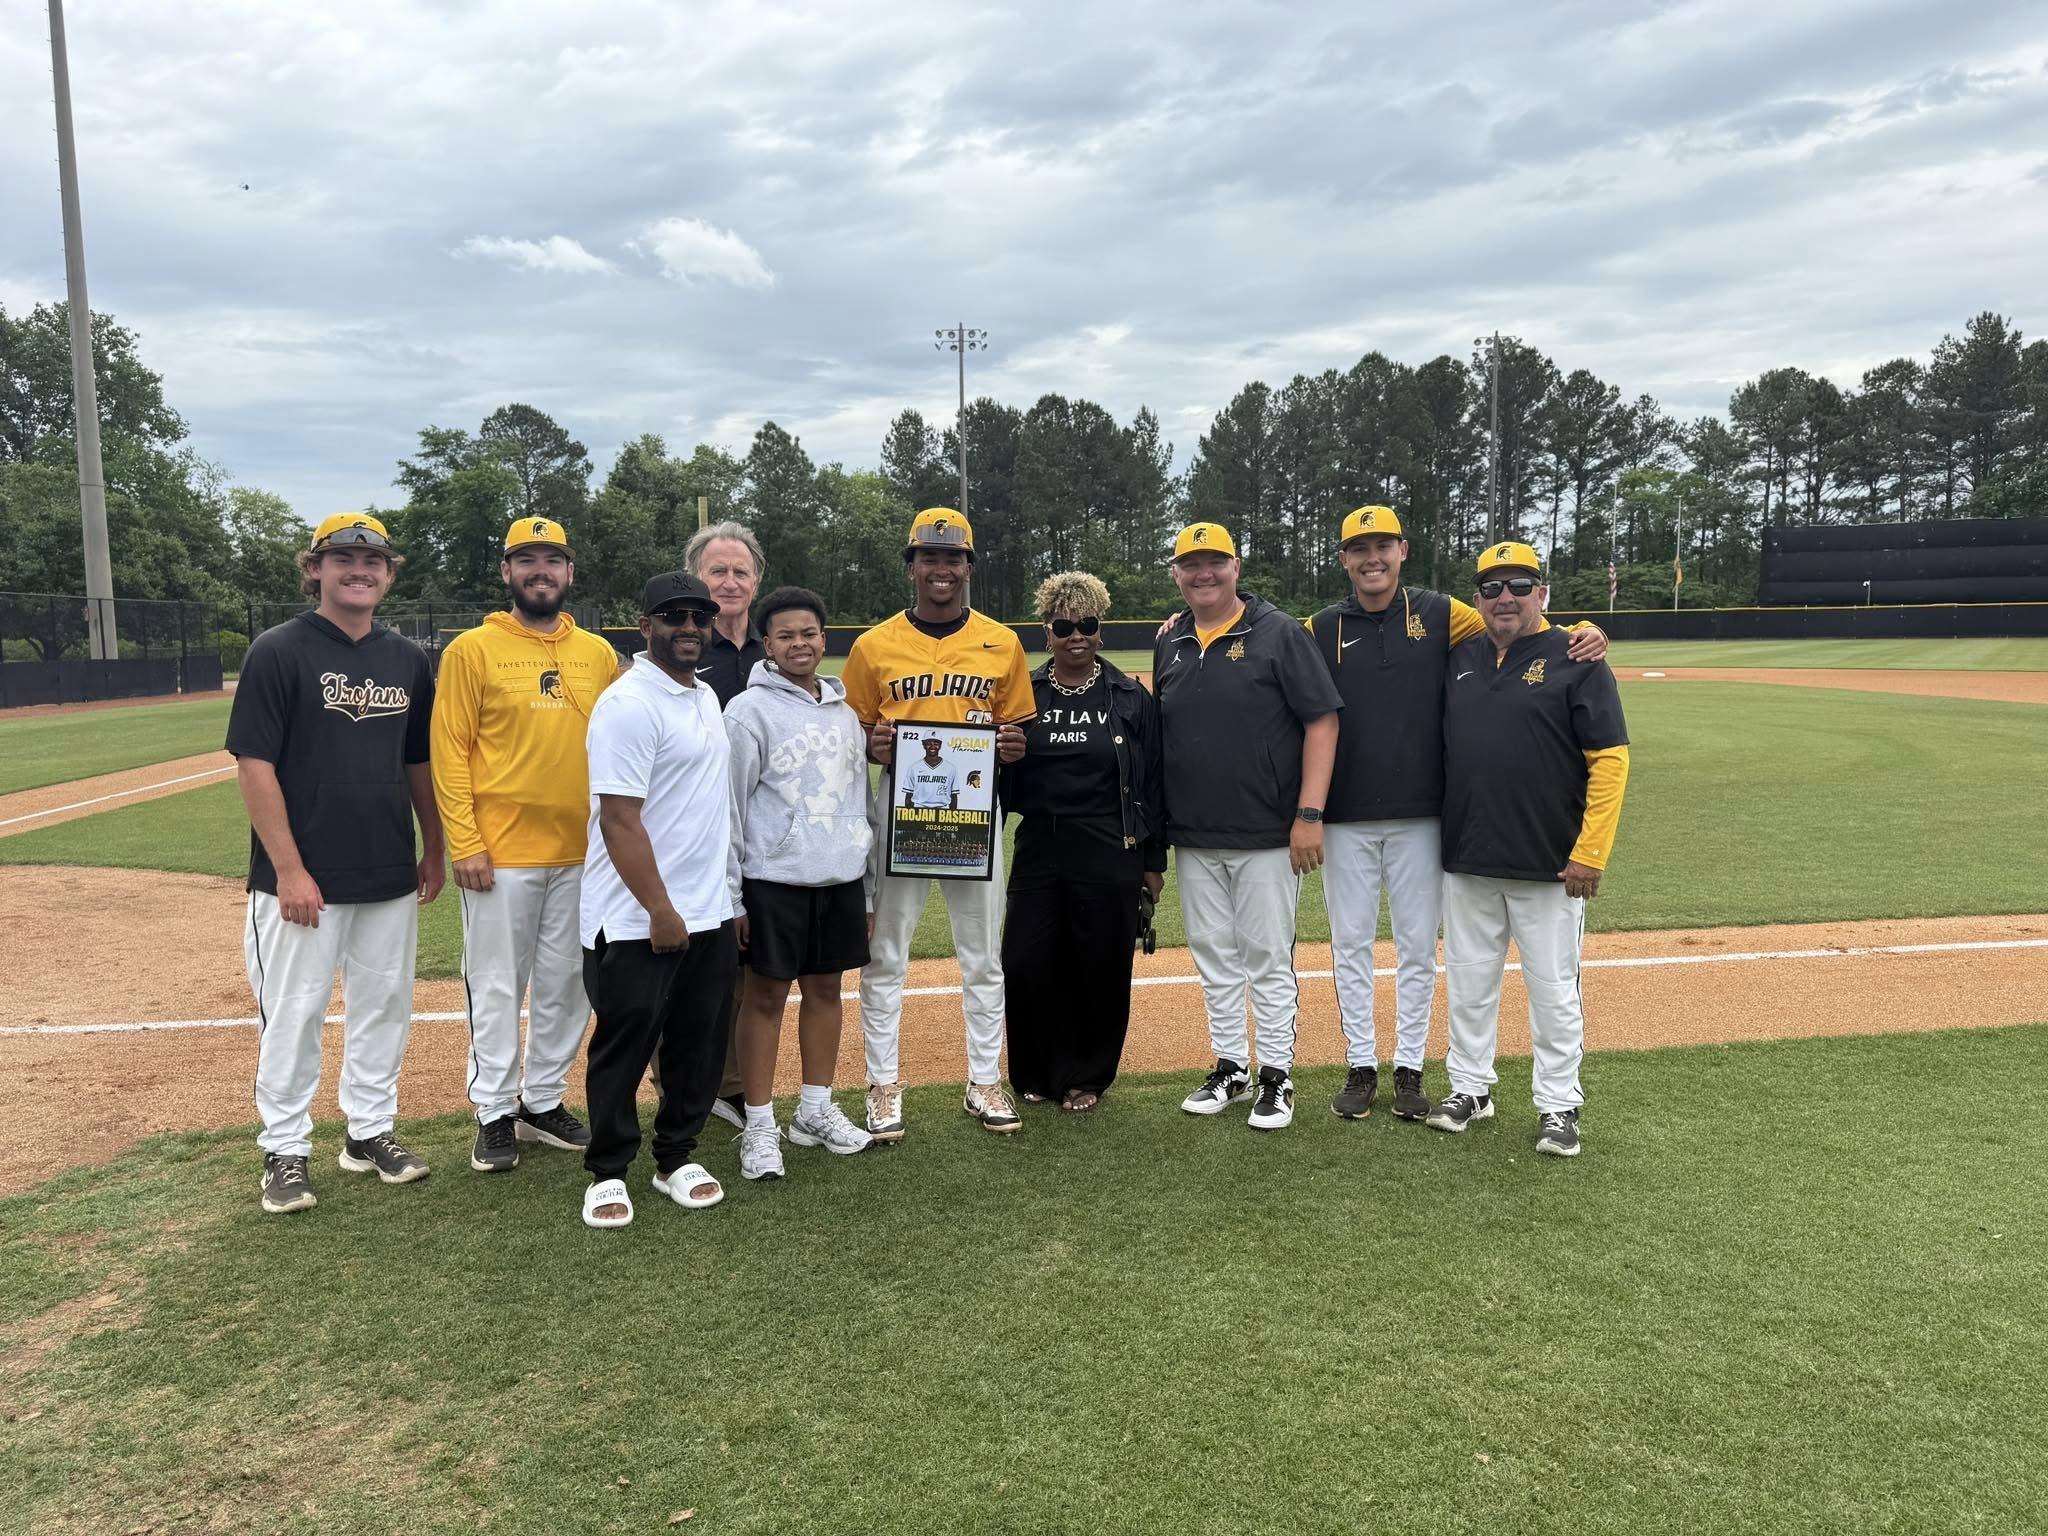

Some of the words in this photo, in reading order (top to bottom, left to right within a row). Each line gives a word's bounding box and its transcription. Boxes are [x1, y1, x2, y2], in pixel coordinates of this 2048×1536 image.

[320, 672, 409, 716] Trojans
[888, 673, 995, 702] TROJANS
[1038, 709, 1063, 724] ST
[1070, 711, 1091, 724] LA
[902, 731, 919, 740] #22
[1049, 731, 1088, 743] PARIS
[946, 736, 990, 749] JOSIAH
[917, 775, 948, 784] TROJANS
[896, 807, 936, 822] TROJAN
[938, 810, 990, 825] BASEBALL
[925, 824, 959, 832] 2024-2025
